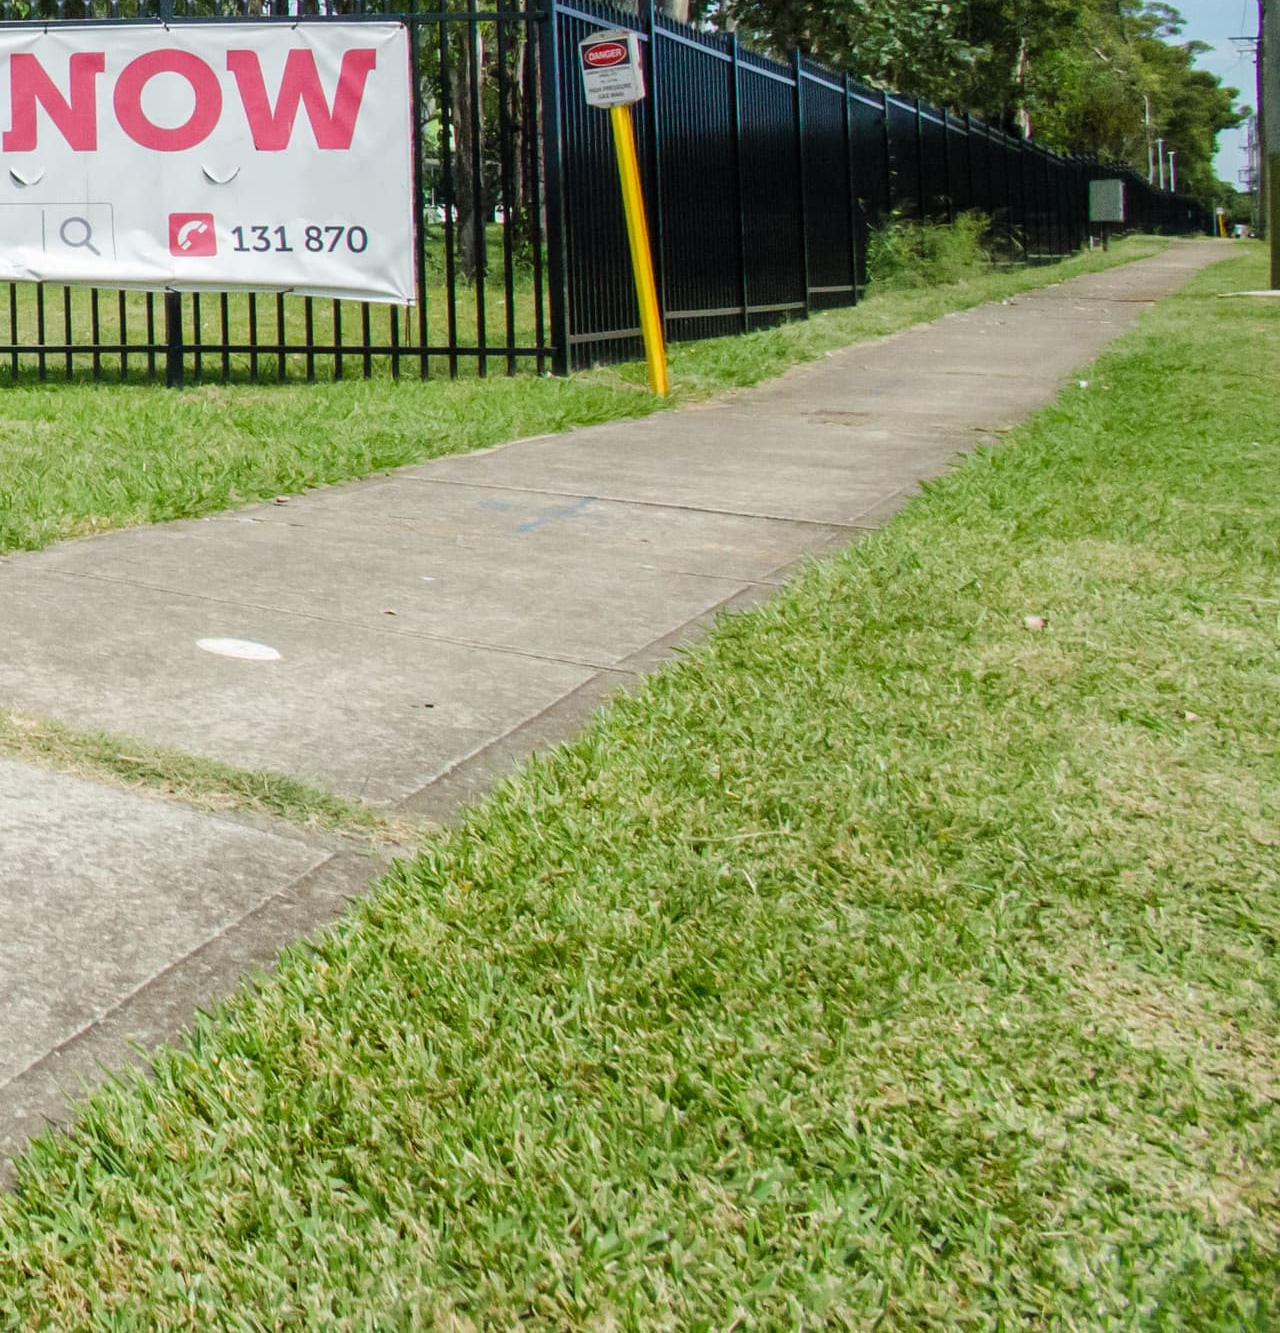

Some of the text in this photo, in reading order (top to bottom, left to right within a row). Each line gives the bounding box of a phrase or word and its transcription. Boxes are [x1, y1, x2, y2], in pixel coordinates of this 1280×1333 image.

[589, 48, 622, 61] DANGER
[2, 48, 377, 152] NOW
[231, 225, 369, 254] 131 870
